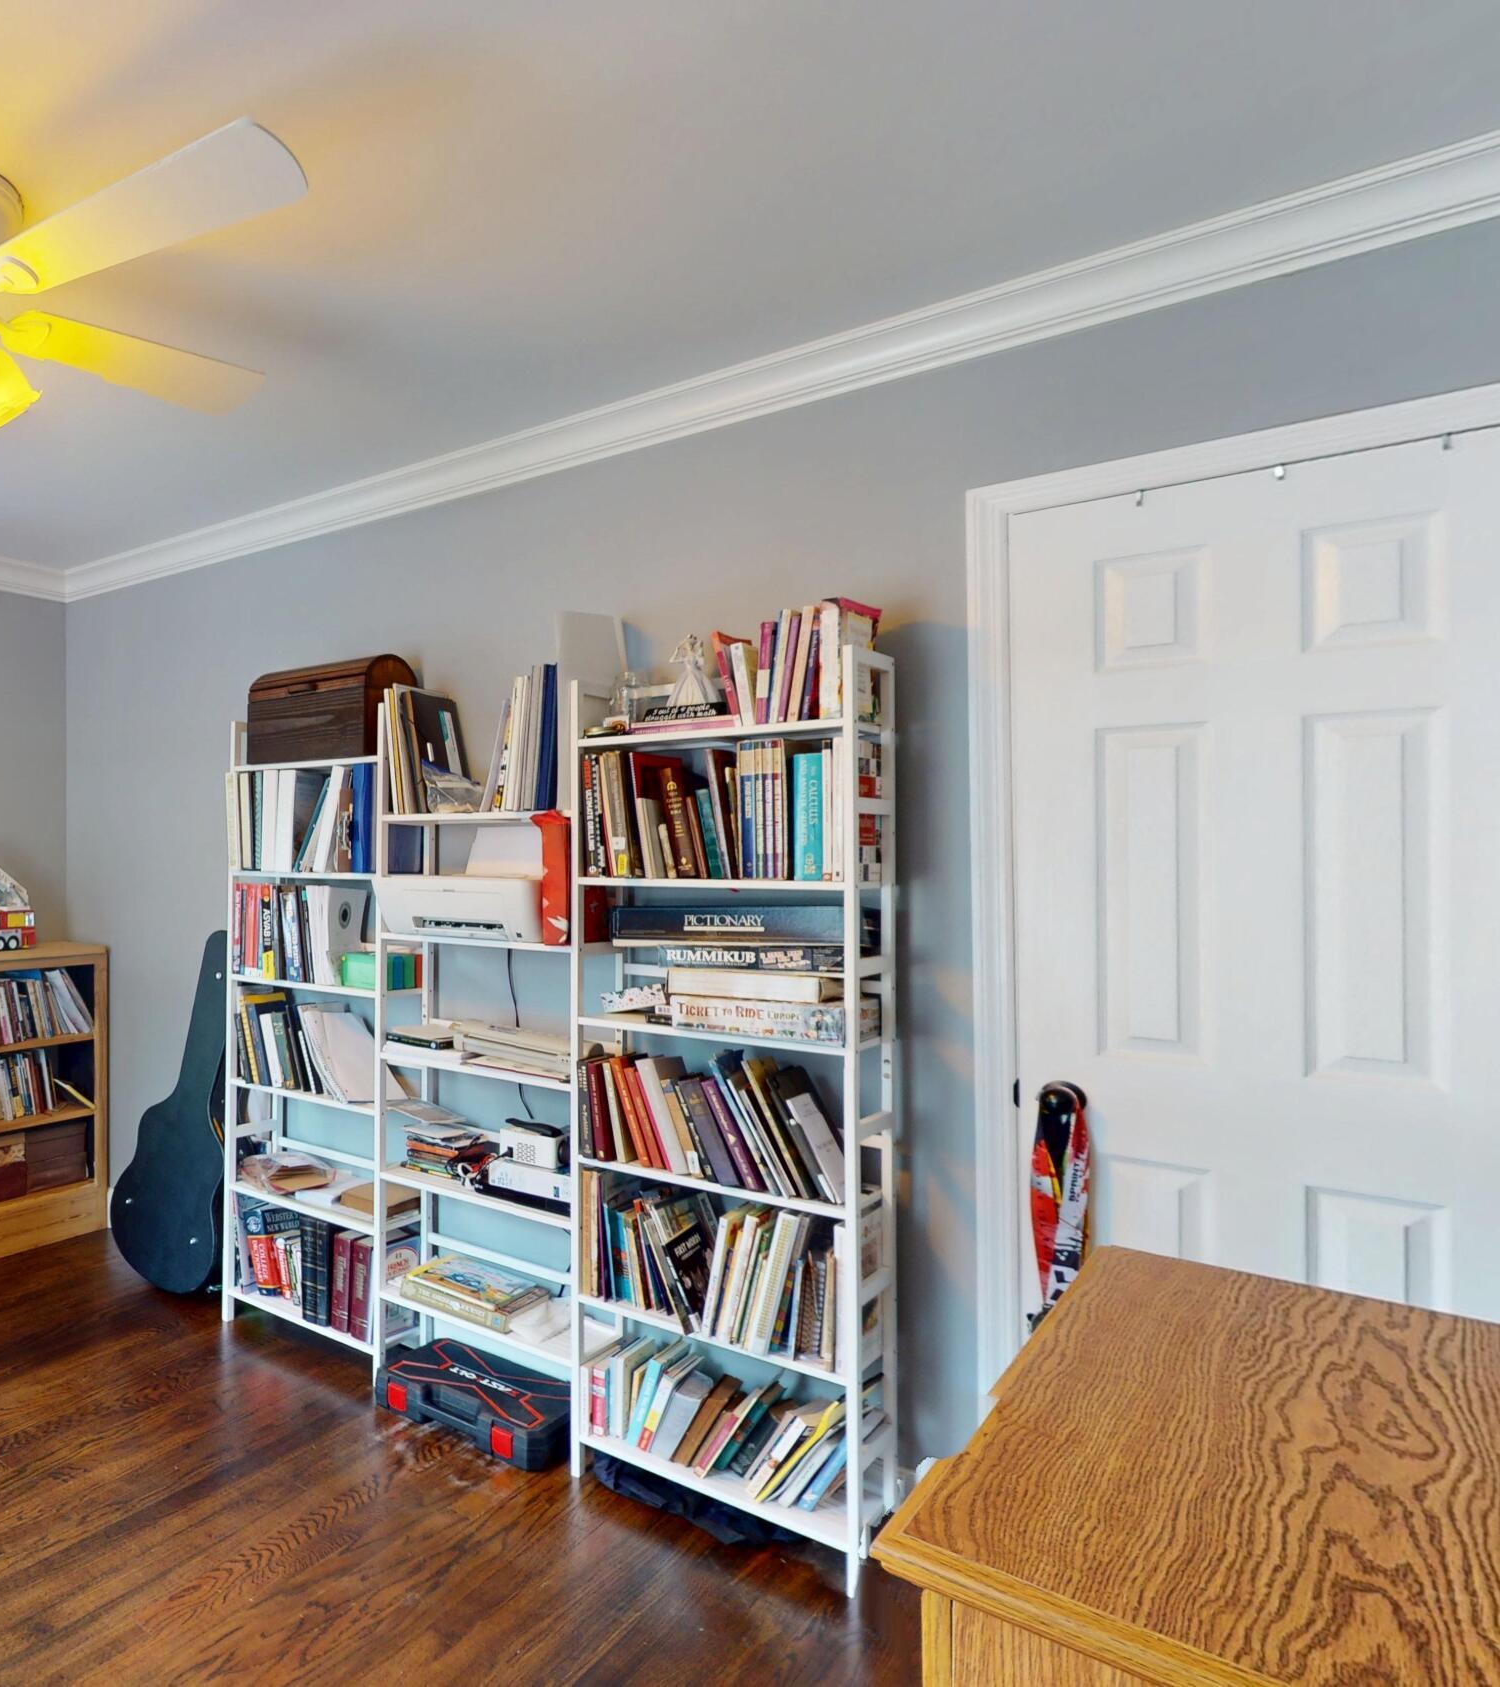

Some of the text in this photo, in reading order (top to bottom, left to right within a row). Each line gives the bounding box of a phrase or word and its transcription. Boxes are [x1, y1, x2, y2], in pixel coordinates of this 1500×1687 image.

[696, 708, 717, 717] math
[585, 789, 594, 820] ULTIMATE
[808, 780, 819, 825] CALCULUS
[587, 820, 596, 851] GRILLING
[263, 908, 272, 937] ASVAB
[683, 914, 764, 927] PICTIONARY
[666, 948, 756, 964] RUMMIKUB
[677, 1002, 720, 1018] TICKET
[735, 1005, 764, 1020] RIDE
[264, 1210, 299, 1223] WEBSTER'S
[266, 1222, 280, 1232] NEW
[251, 1240, 264, 1284] DICTIONARY
[258, 1243, 269, 1280] COLLEGE
[278, 1247, 289, 1286] Dictionary
